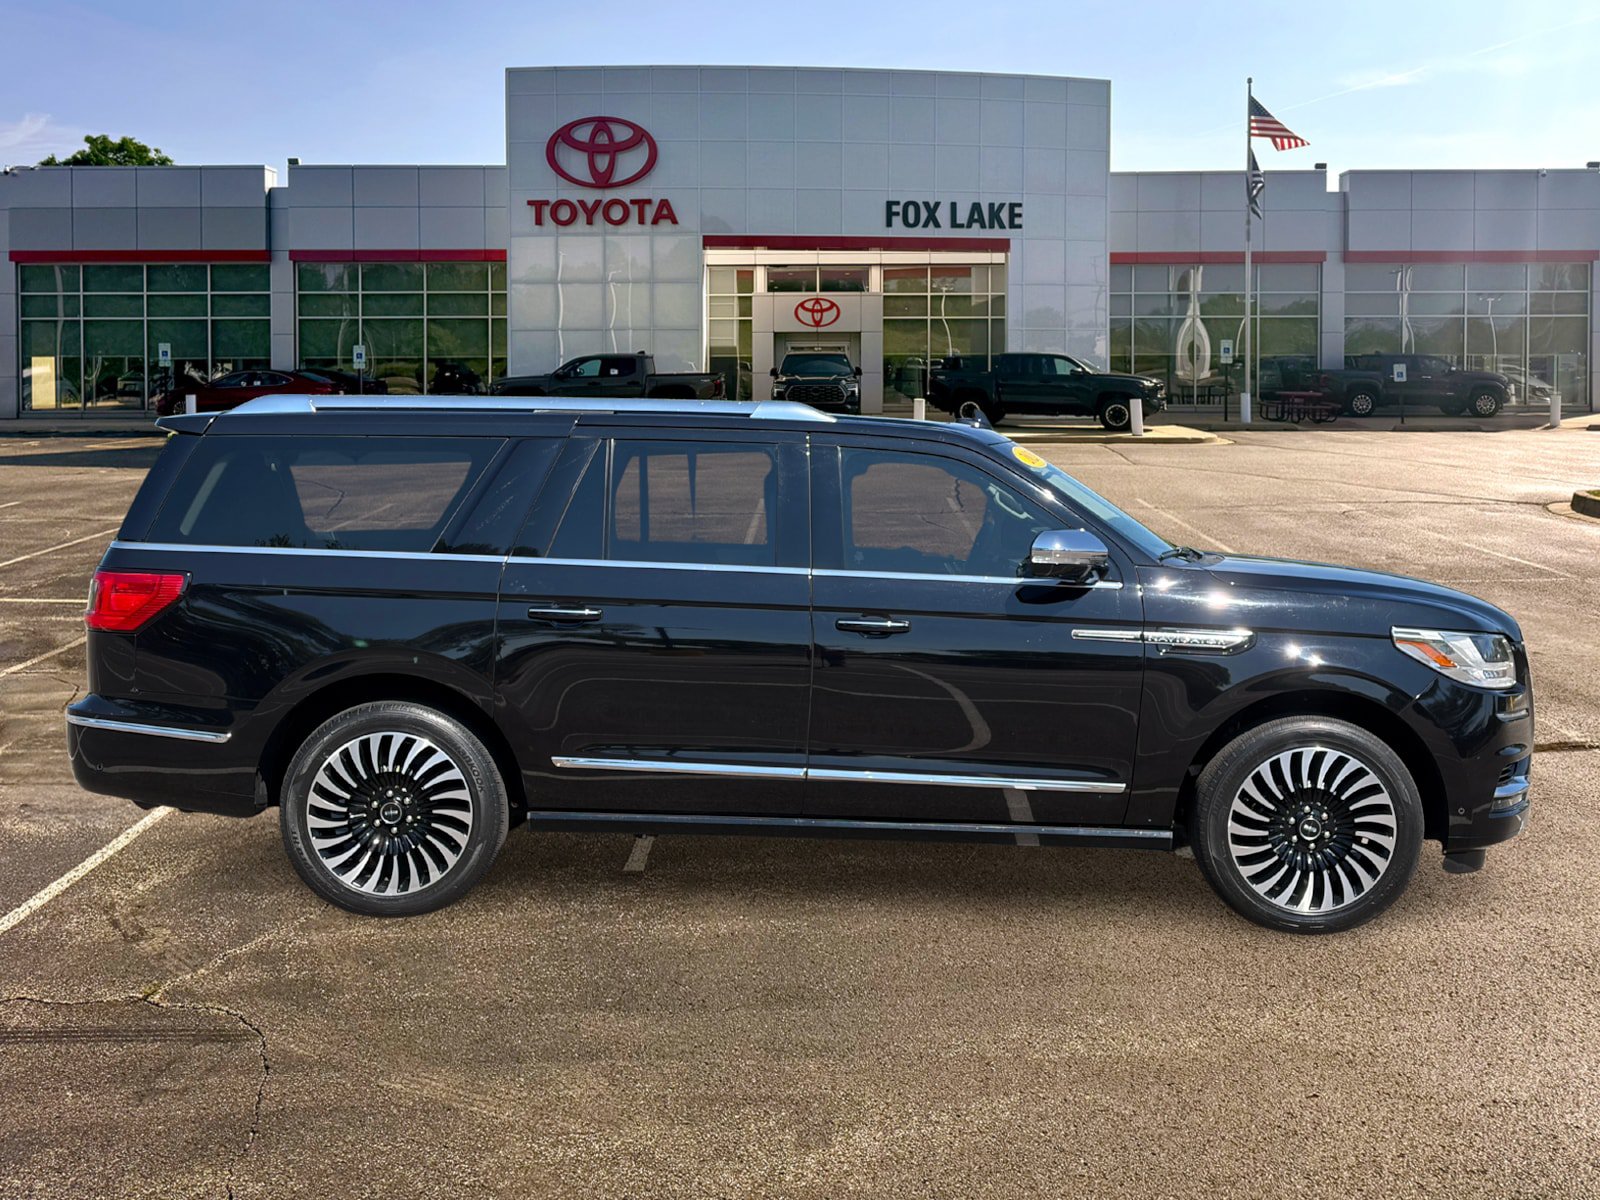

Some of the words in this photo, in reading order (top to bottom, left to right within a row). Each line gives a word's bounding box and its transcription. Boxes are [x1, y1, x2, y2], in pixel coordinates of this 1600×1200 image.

[527, 199, 678, 226] TOYOTA
[885, 200, 942, 228] FOX
[950, 201, 1023, 229] LAKE
